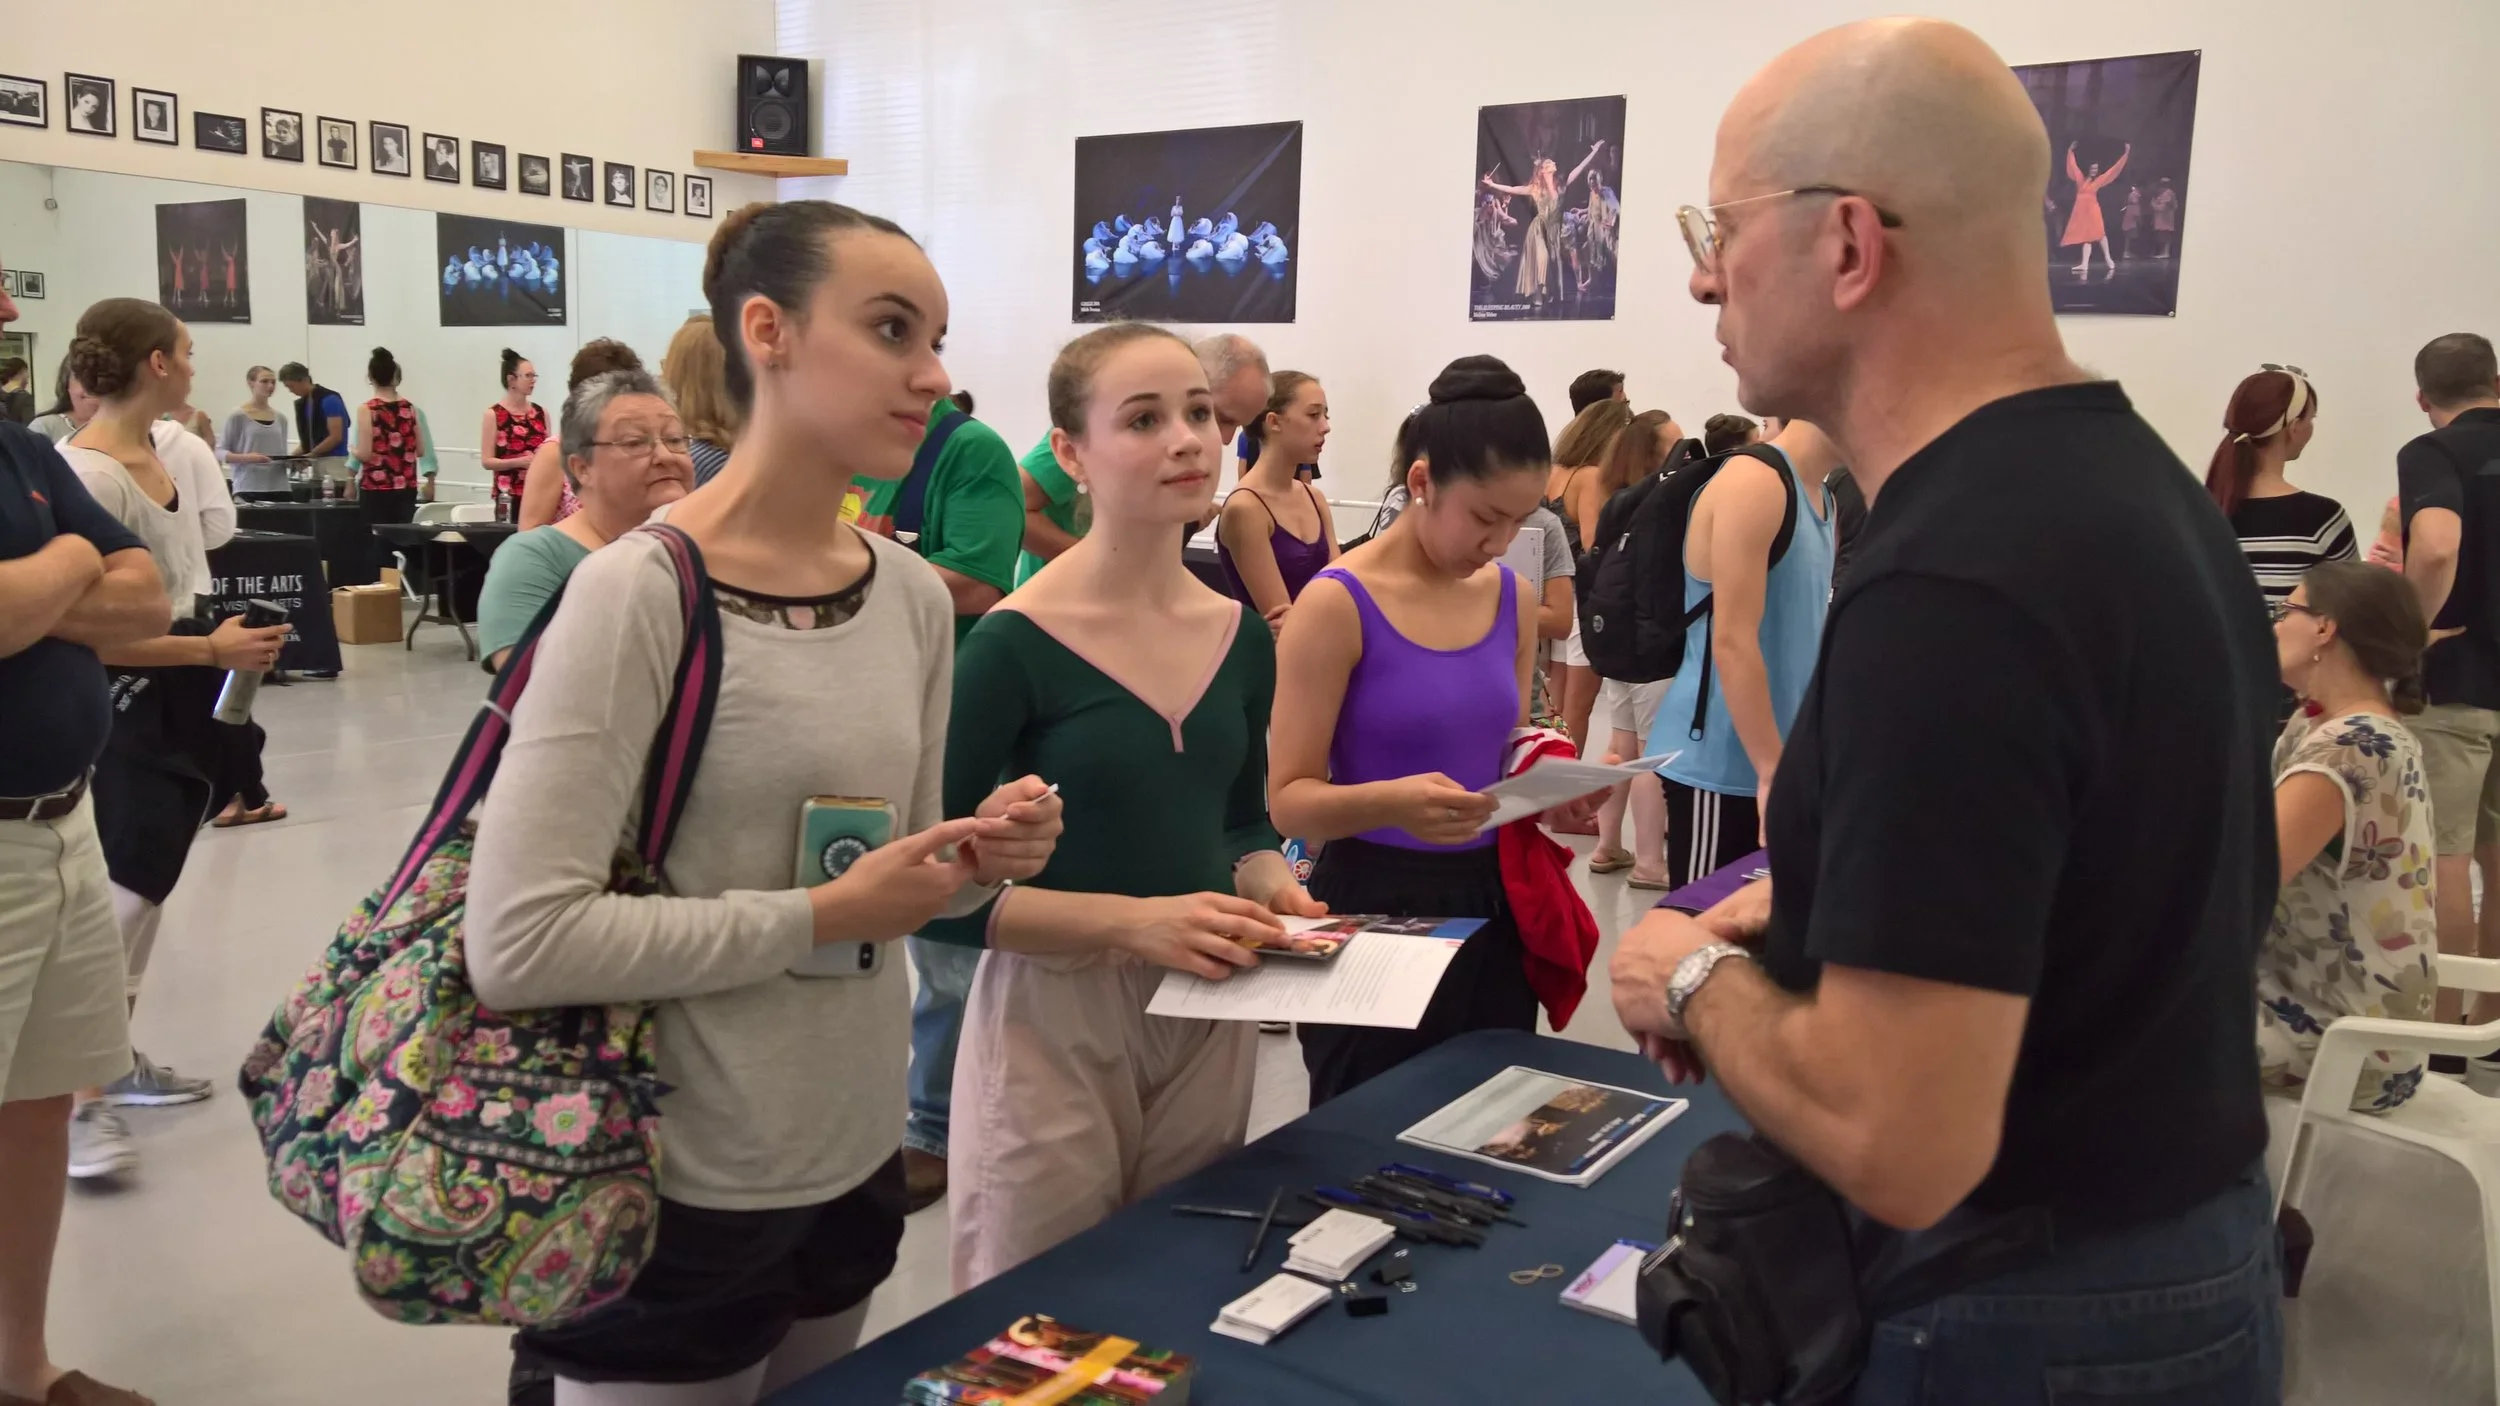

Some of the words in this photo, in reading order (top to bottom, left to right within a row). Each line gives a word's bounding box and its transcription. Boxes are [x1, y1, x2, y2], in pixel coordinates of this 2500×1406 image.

[212, 577, 229, 595] OF
[236, 576, 266, 594] THE
[270, 575, 303, 593] ARTS
[223, 600, 250, 611] VISU
